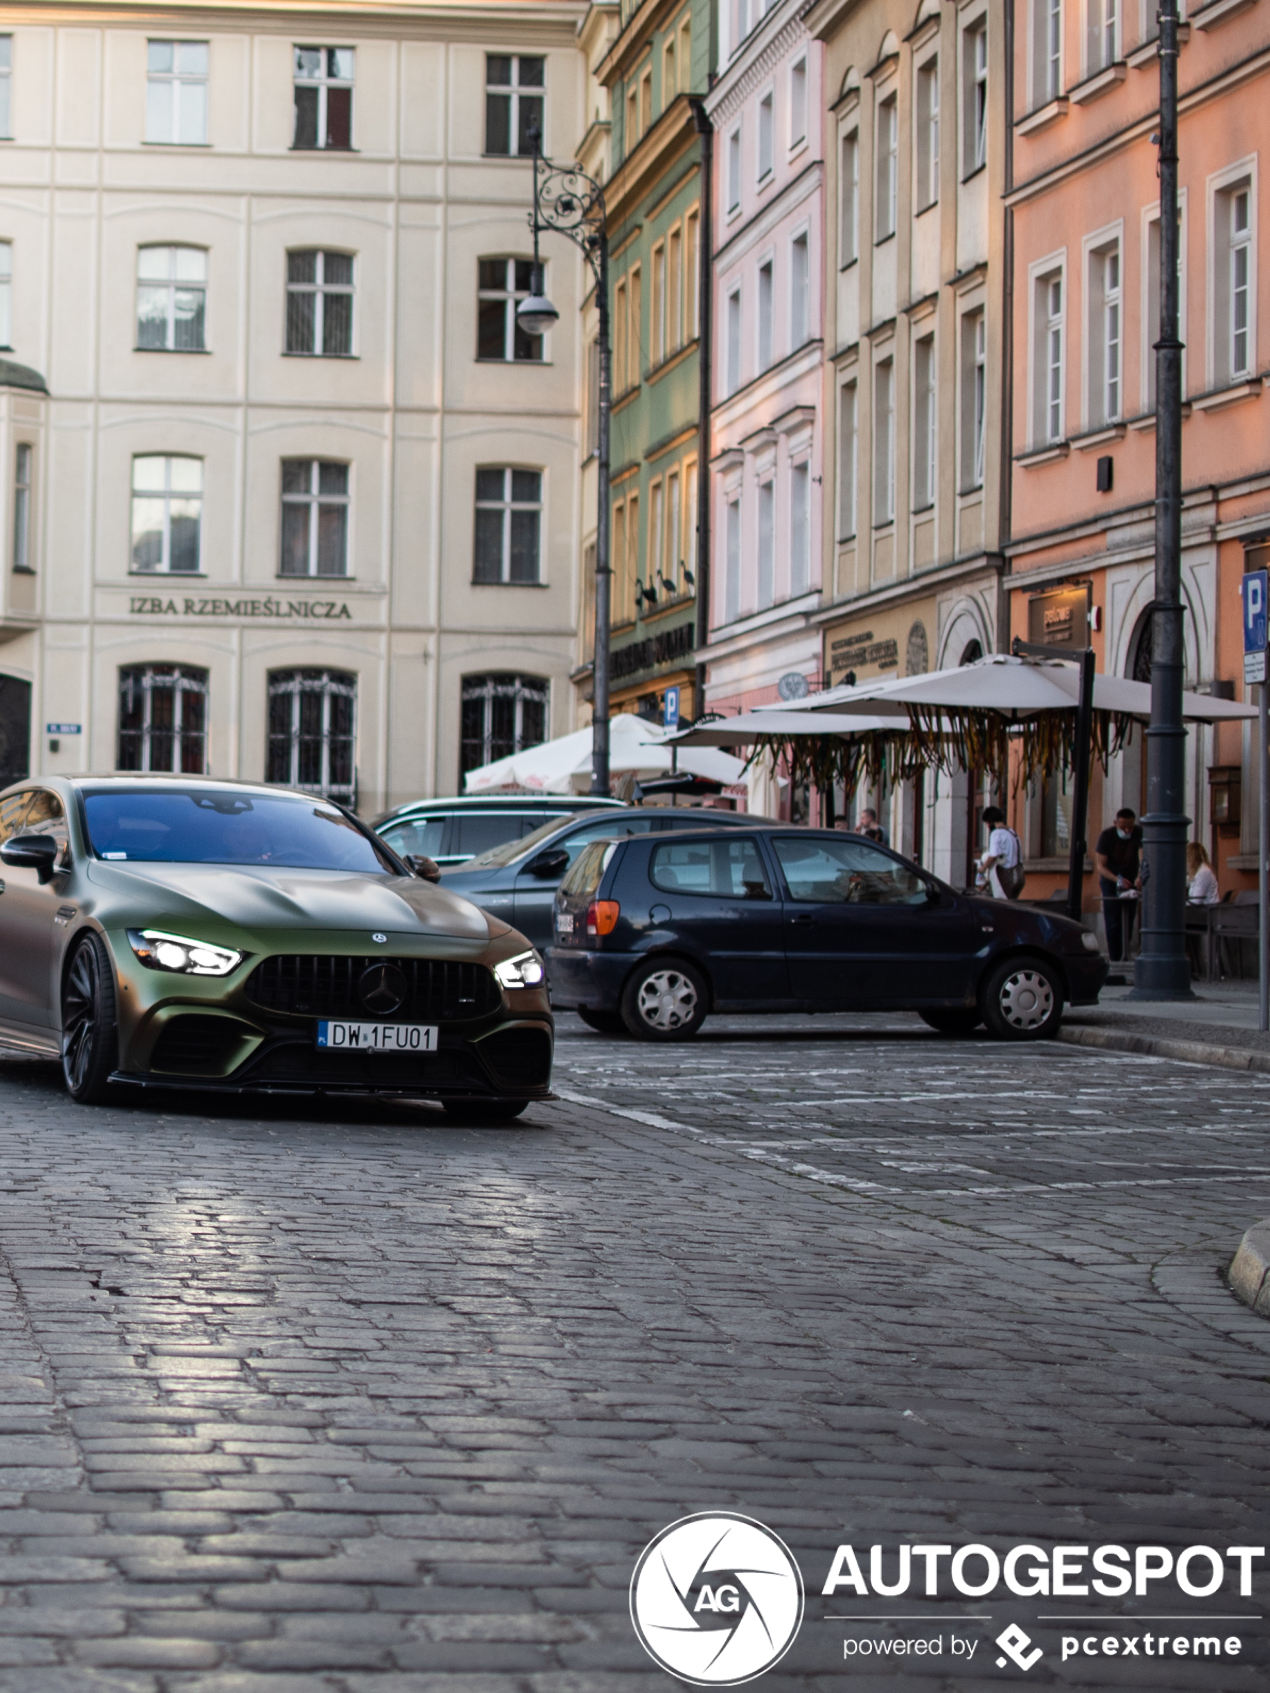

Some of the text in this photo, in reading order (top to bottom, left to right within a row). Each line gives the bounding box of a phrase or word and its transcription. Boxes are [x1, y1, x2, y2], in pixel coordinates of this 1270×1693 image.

[129, 596, 352, 619] IZBA RZEMIEŚLNICZA
[1248, 579, 1262, 629] P
[667, 691, 677, 721] P
[333, 1024, 431, 1050] DW 1FU01
